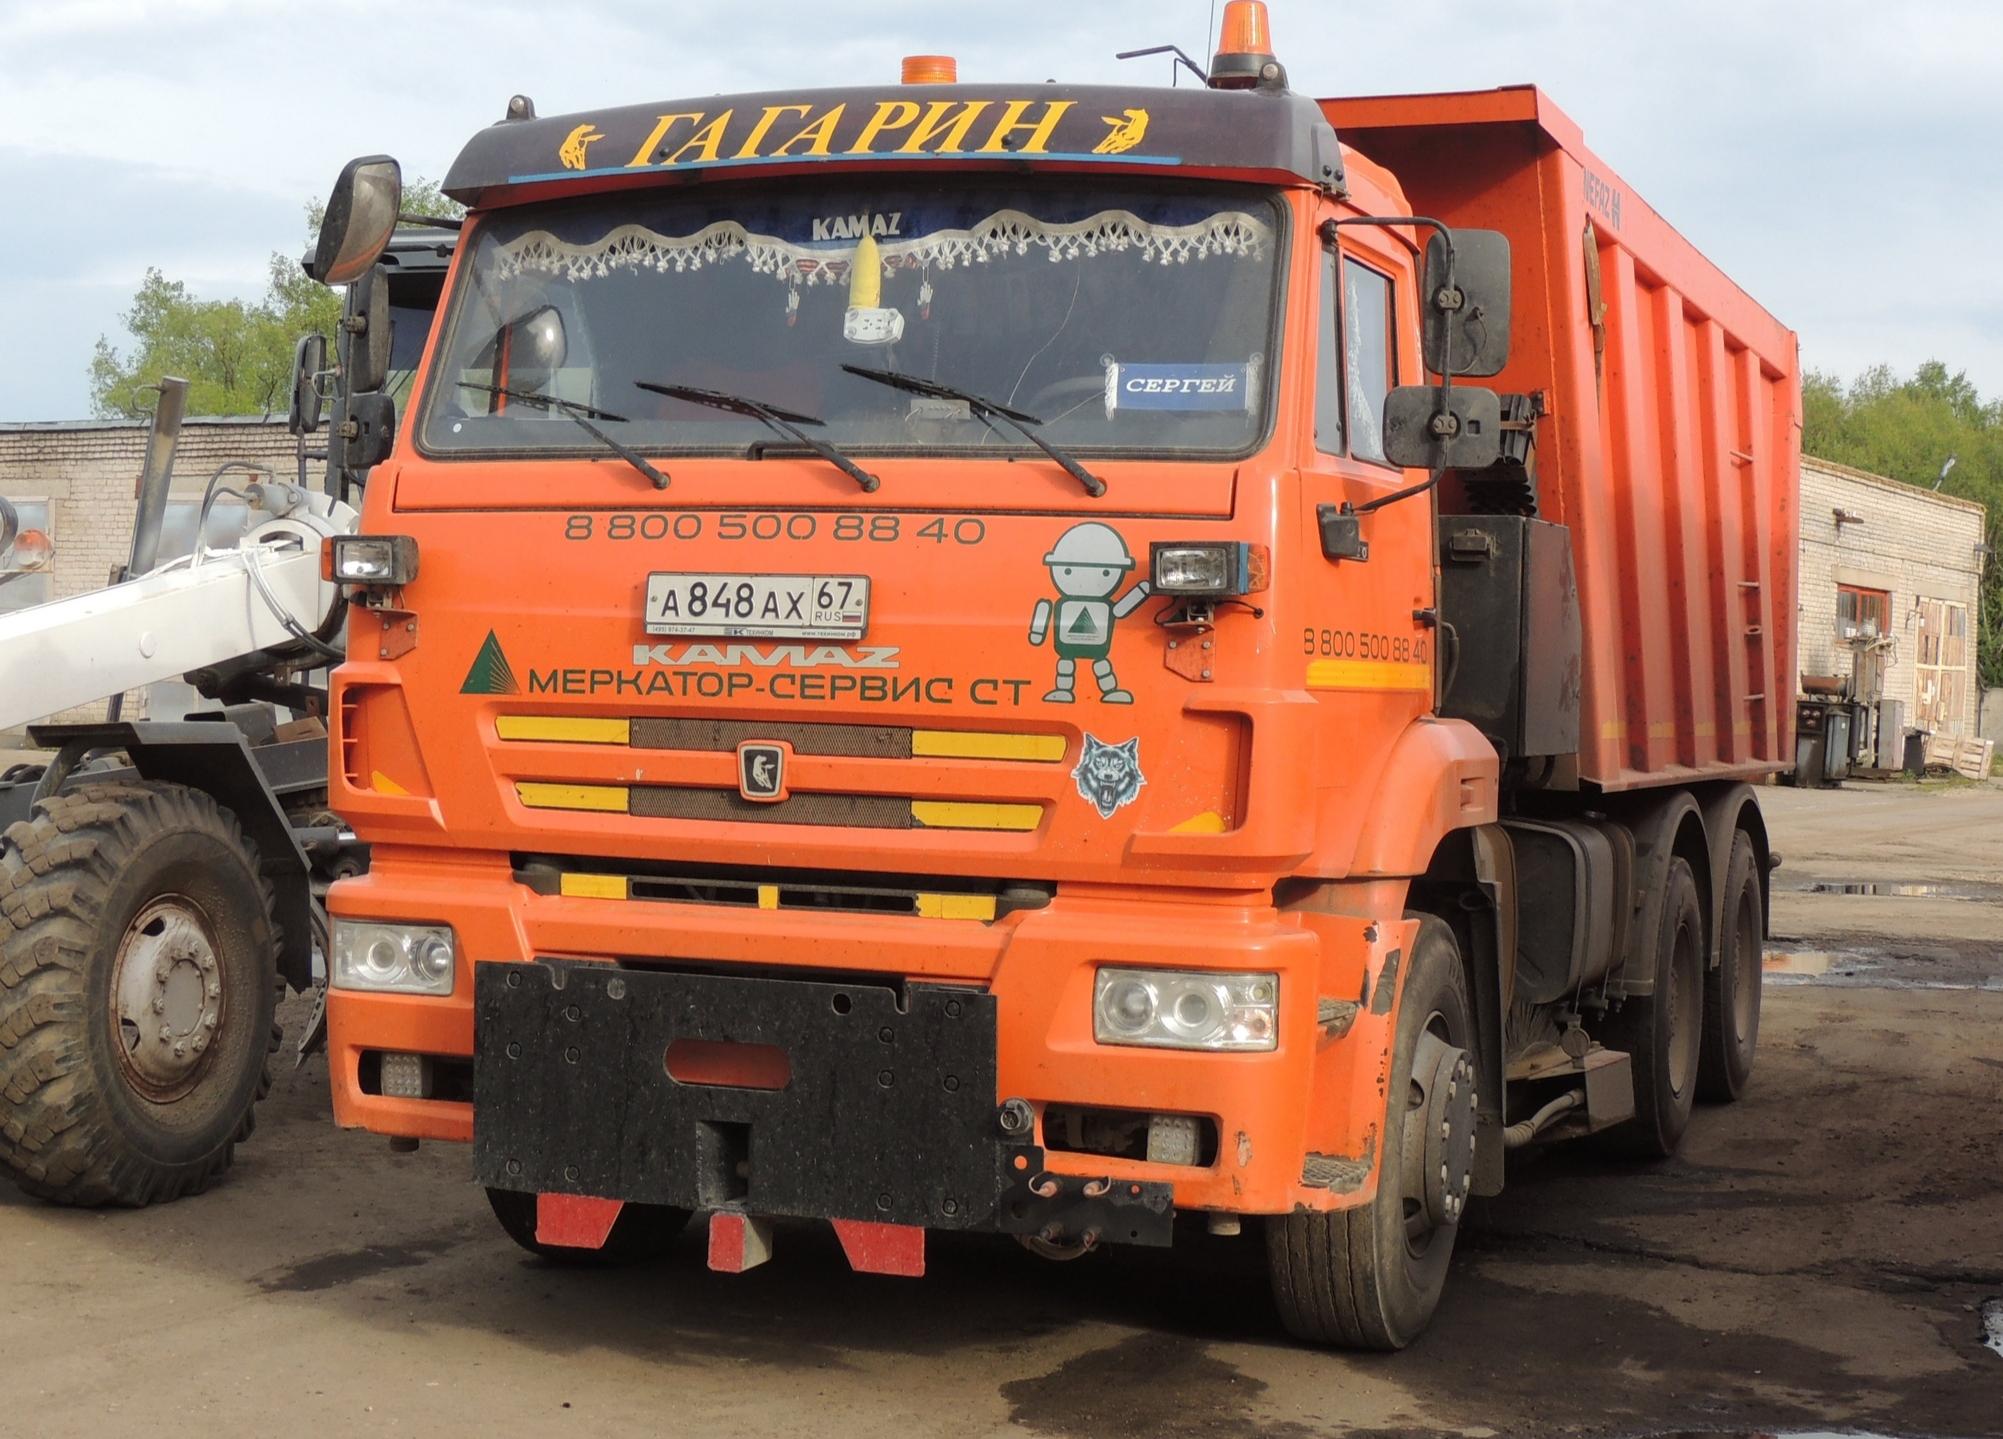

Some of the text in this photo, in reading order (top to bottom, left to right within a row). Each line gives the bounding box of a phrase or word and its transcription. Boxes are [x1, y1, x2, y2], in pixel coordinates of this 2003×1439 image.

[624, 100, 1078, 168] ГАГАРИН
[812, 212, 902, 241] KAMAZ
[1126, 374, 1237, 393] СЕРГЕЙ
[564, 514, 987, 545] 8 800 500 88 40
[816, 580, 854, 610] 67
[814, 611, 841, 622] RUS
[632, 643, 901, 668] KAMAZ
[1303, 627, 1427, 665] 8 800 500 88 40
[528, 669, 1032, 706] МЕРКАТОР-СЕРВИС СТ
